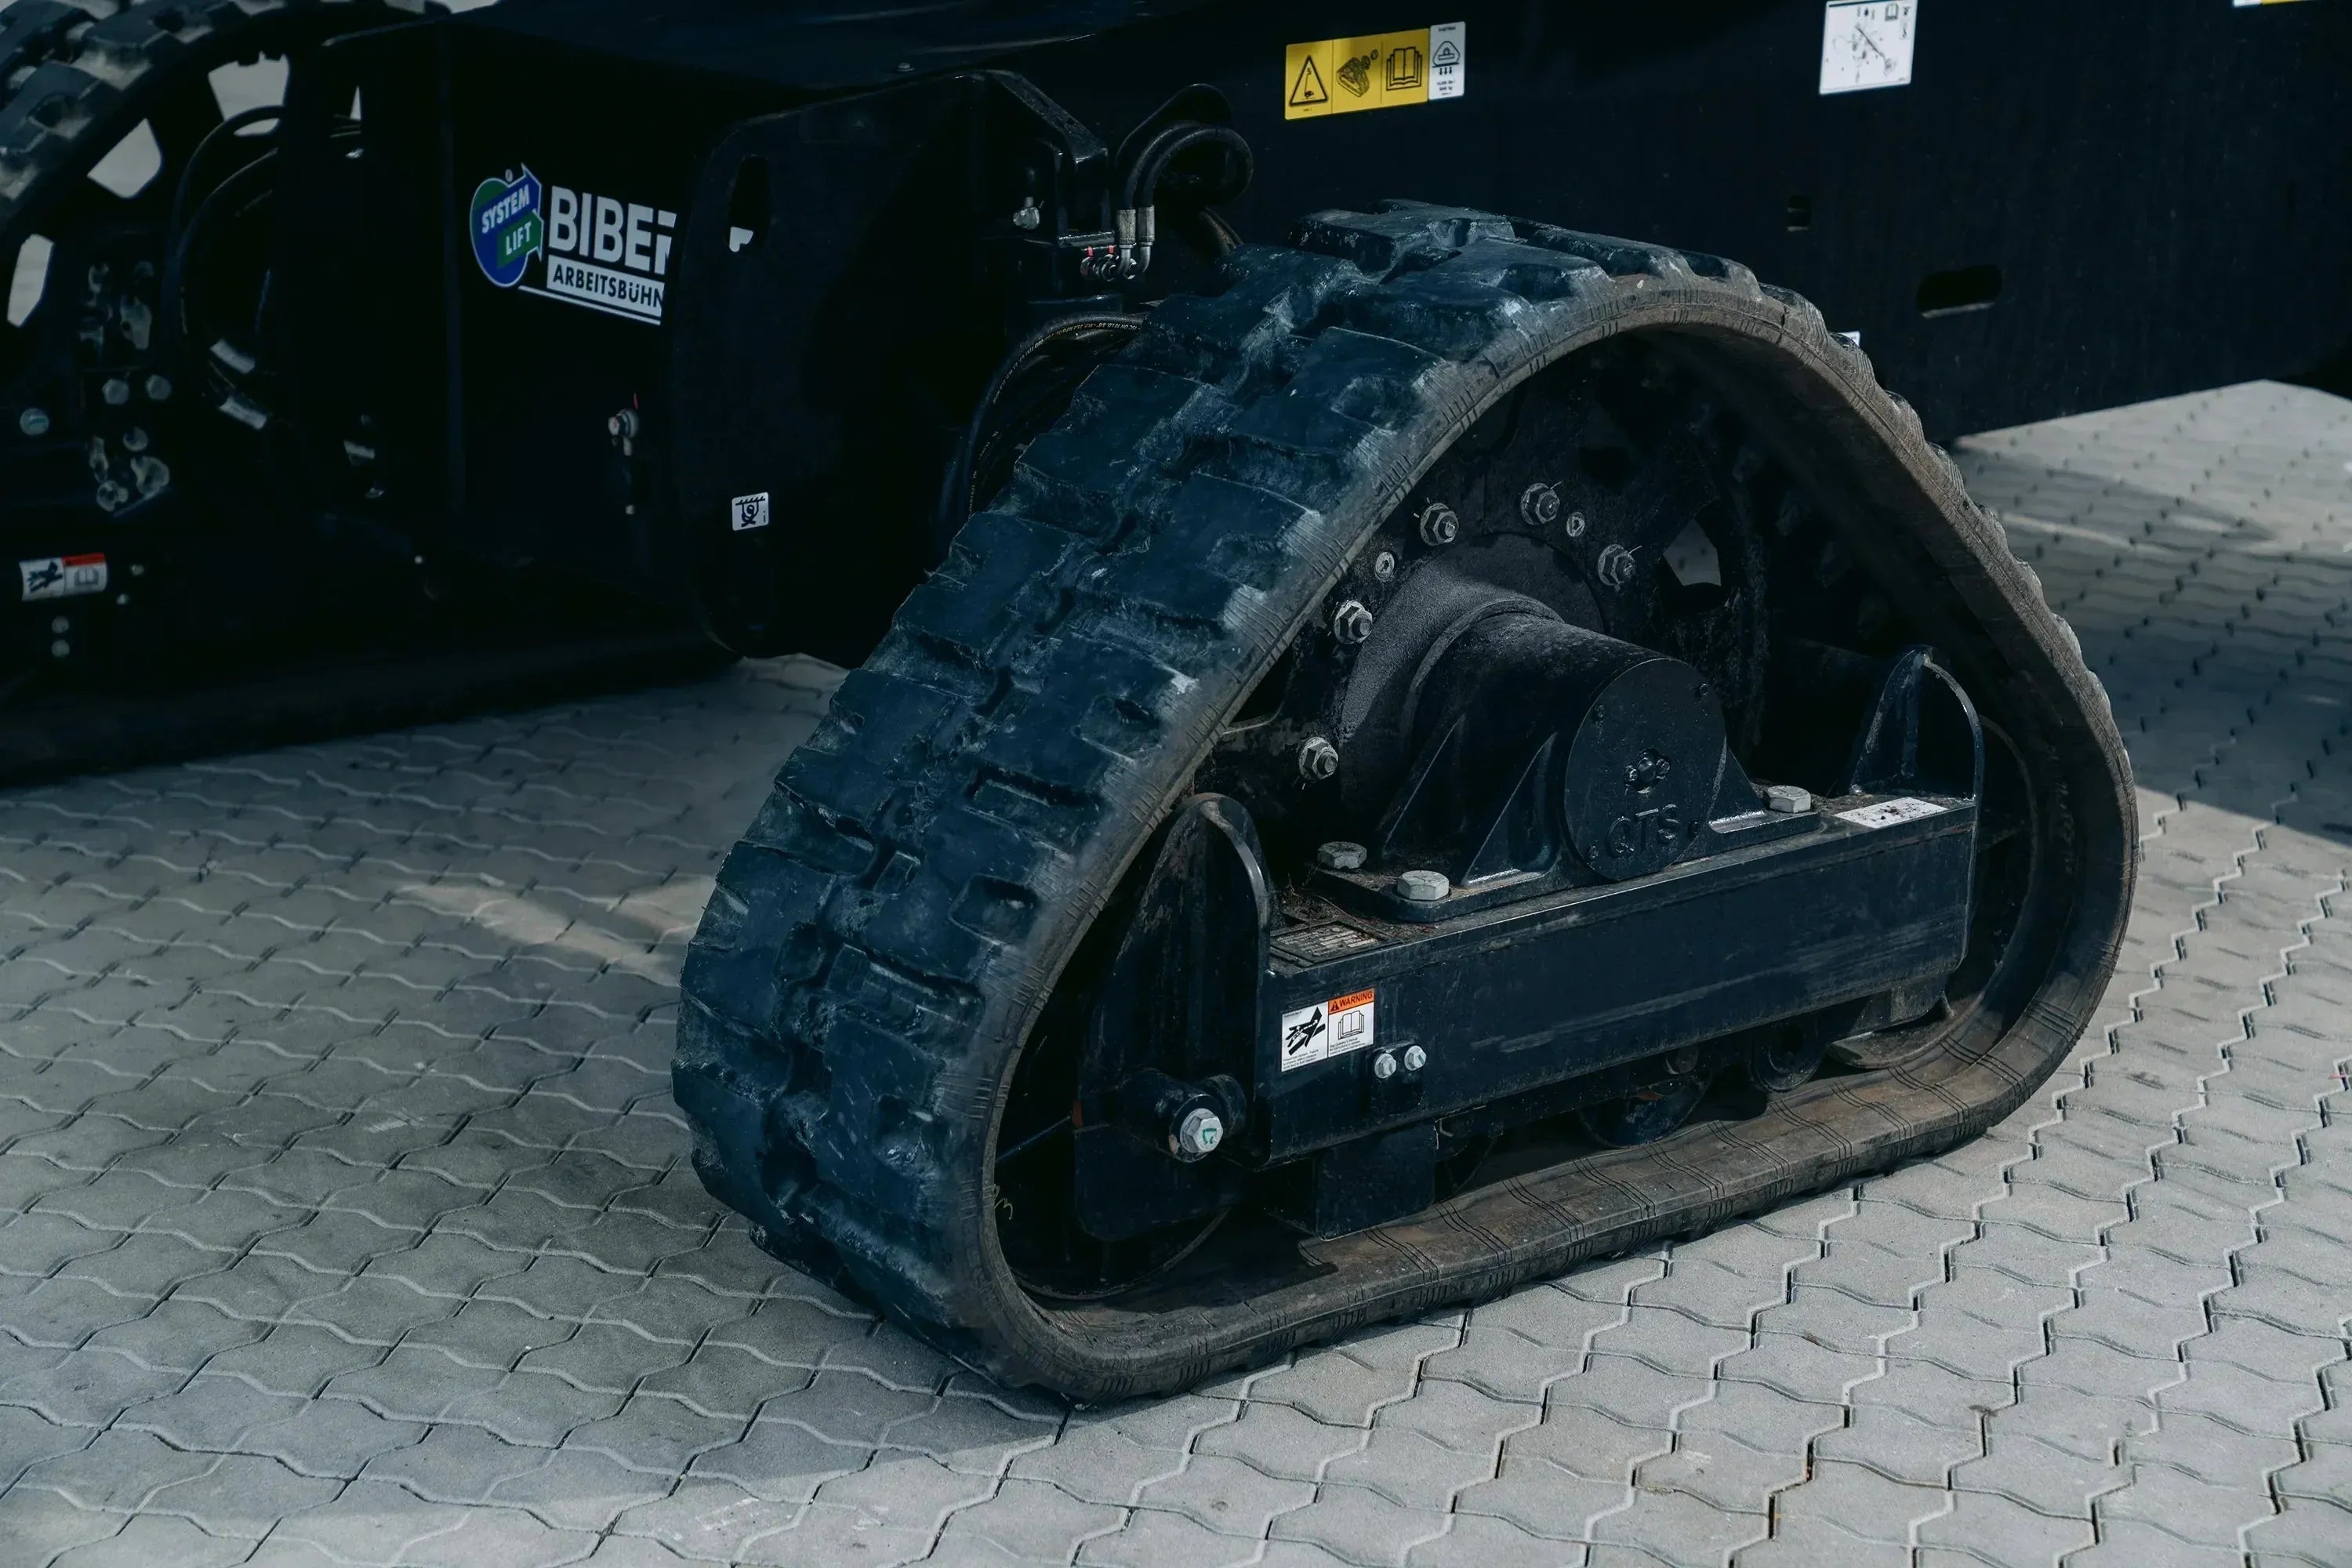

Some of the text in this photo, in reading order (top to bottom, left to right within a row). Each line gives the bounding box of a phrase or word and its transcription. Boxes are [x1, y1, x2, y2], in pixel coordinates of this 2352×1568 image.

[481, 184, 530, 234] SYSTEM
[505, 221, 532, 256] LIFT
[1339, 991, 1373, 1007] WARNING
